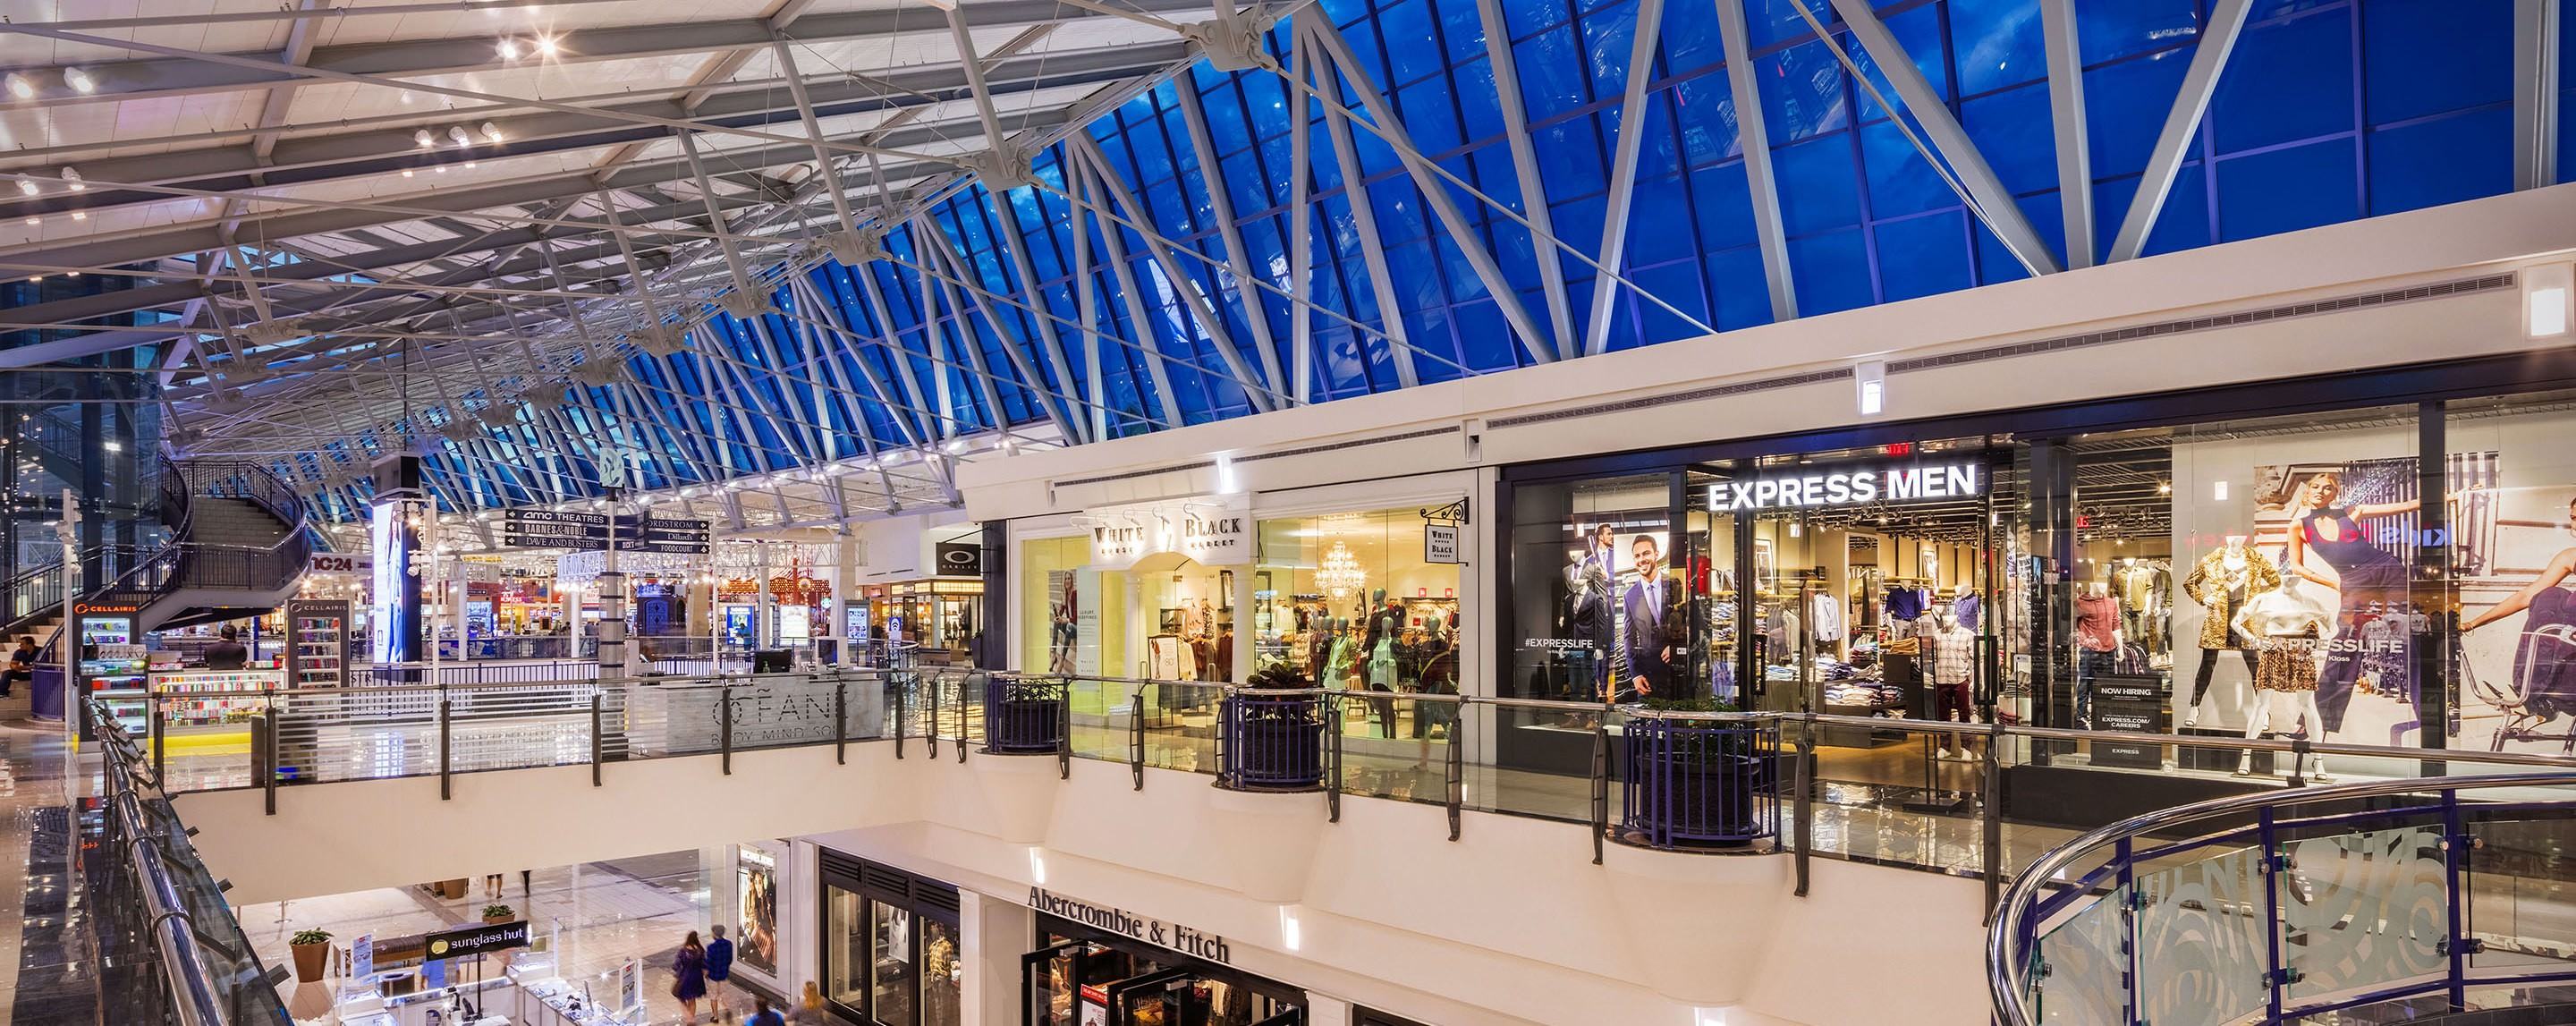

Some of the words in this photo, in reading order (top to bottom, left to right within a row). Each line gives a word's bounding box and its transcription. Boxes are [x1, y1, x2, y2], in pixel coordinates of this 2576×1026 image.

[1709, 471, 1876, 511] EXPRESS
[1887, 464, 1976, 499] MEN
[556, 513, 605, 523] THEATRES
[648, 521, 693, 529] ORDSTROM
[1185, 518, 1241, 538] BLACK
[1095, 527, 1144, 543] WHITE
[1432, 545, 1453, 553] BLACK
[1524, 638, 1594, 649] #EXPRESSLIFE
[2328, 655, 2351, 663] Kloss
[2101, 687, 2122, 695] NOW
[2123, 688, 2152, 696] HIRING
[2102, 717, 2151, 725] EXPRESS.COM/
[711, 731, 753, 746] BDY
[1028, 886, 1142, 938] Abercrombie
[1149, 920, 1166, 945] &
[1174, 923, 1231, 964] Fitch
[451, 933, 502, 949] sunglass
[504, 928, 523, 940] hut
